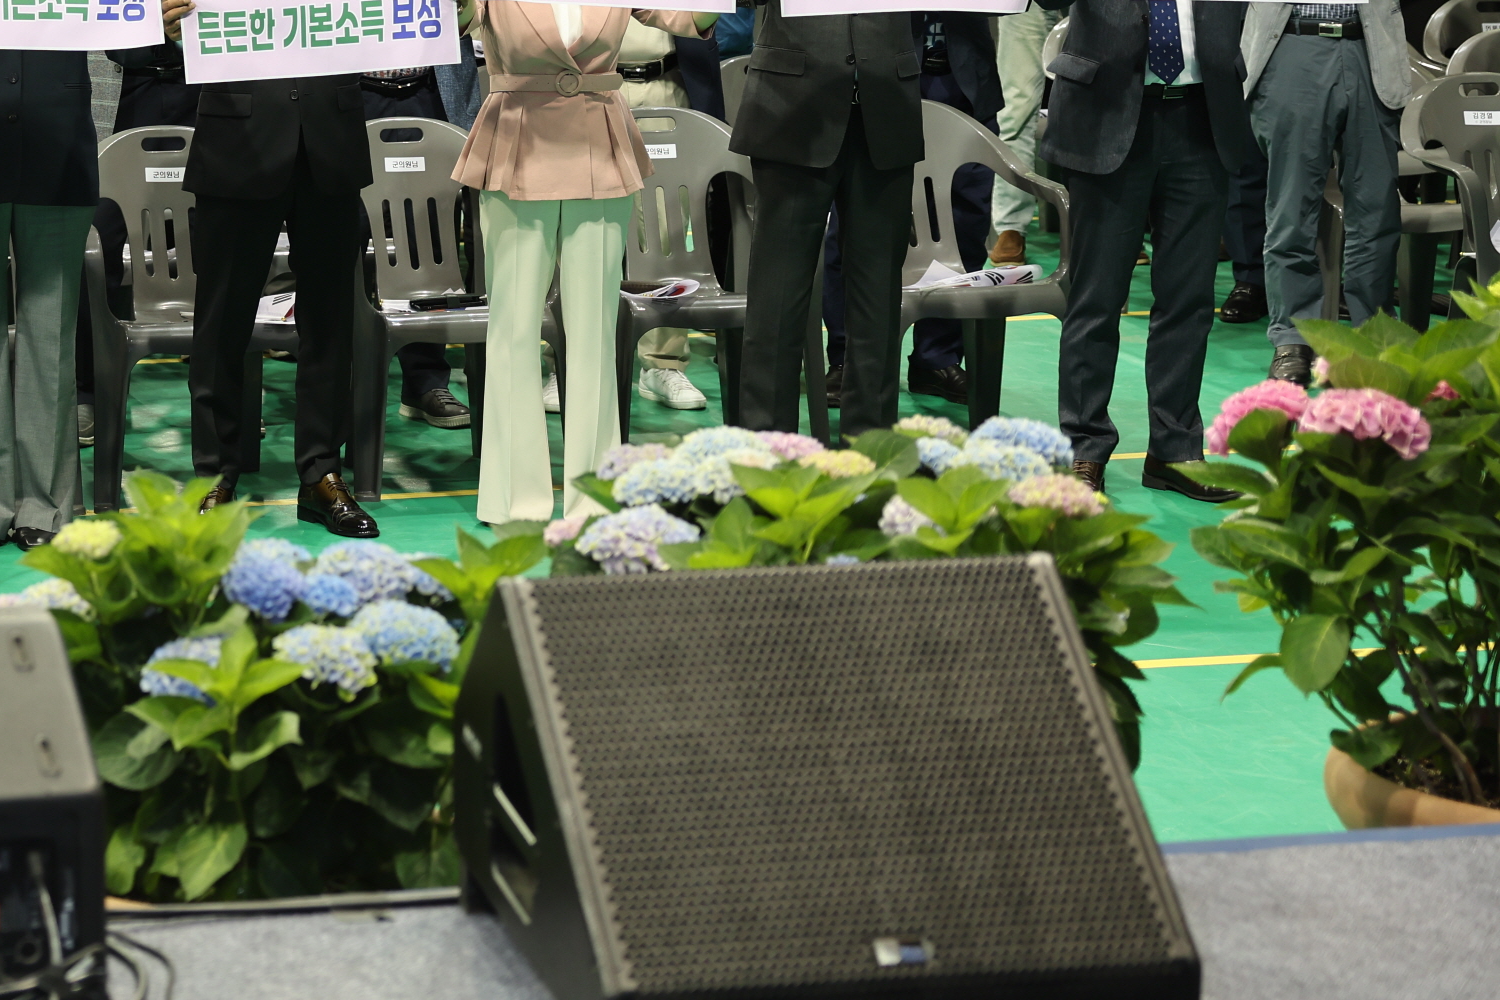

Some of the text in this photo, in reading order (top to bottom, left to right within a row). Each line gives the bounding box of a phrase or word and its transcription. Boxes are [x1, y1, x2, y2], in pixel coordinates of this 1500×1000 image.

[198, 8, 276, 55] 든든한
[283, 0, 385, 48] 기본소득
[392, 160, 419, 168] 군의원님
[153, 171, 180, 179] 군의원님
